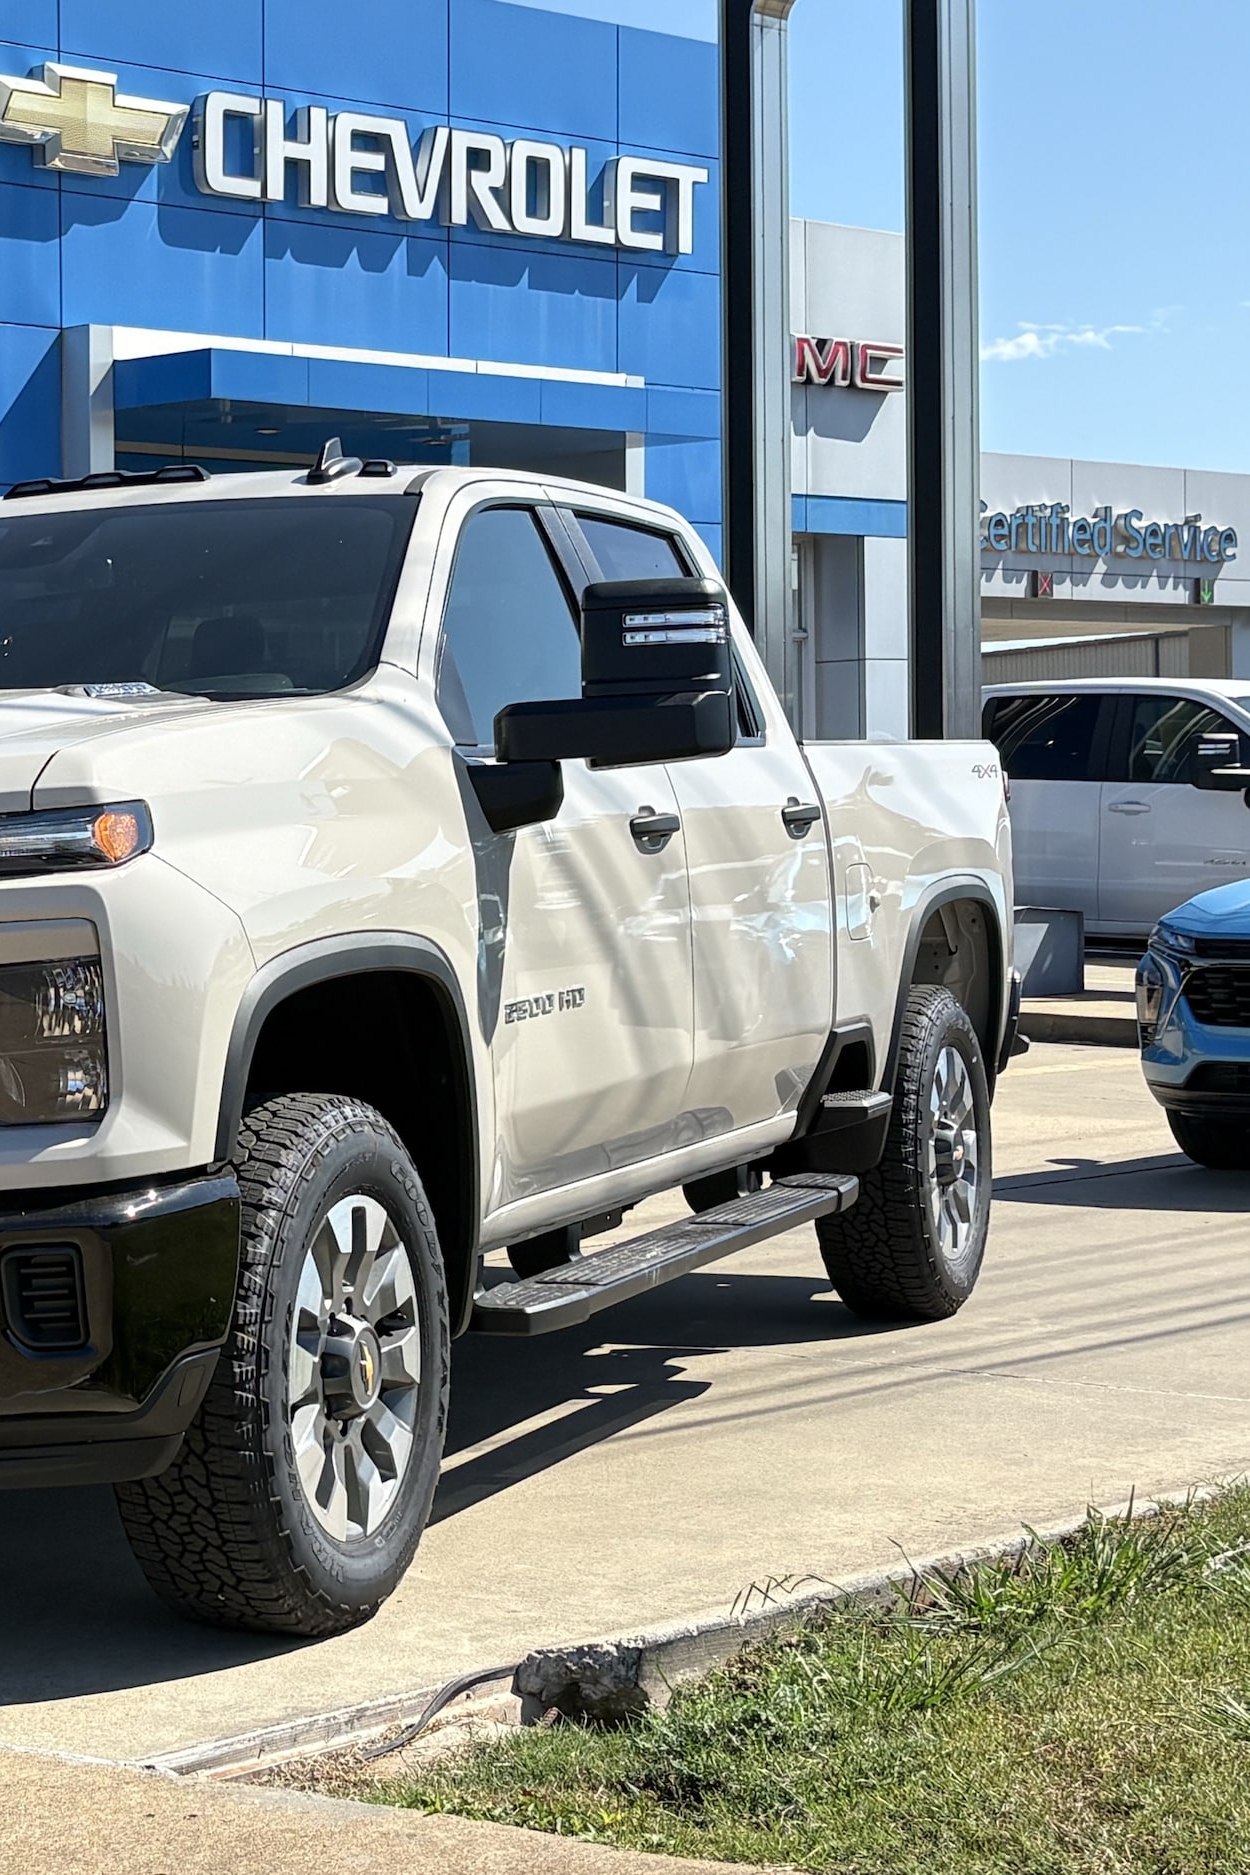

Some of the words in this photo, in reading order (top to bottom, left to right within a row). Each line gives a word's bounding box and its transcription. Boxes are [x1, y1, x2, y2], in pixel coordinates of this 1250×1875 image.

[194, 90, 710, 256] CHEVROLET
[791, 334, 905, 392] MC
[1123, 508, 1238, 562] Service
[558, 987, 585, 1012] HD
